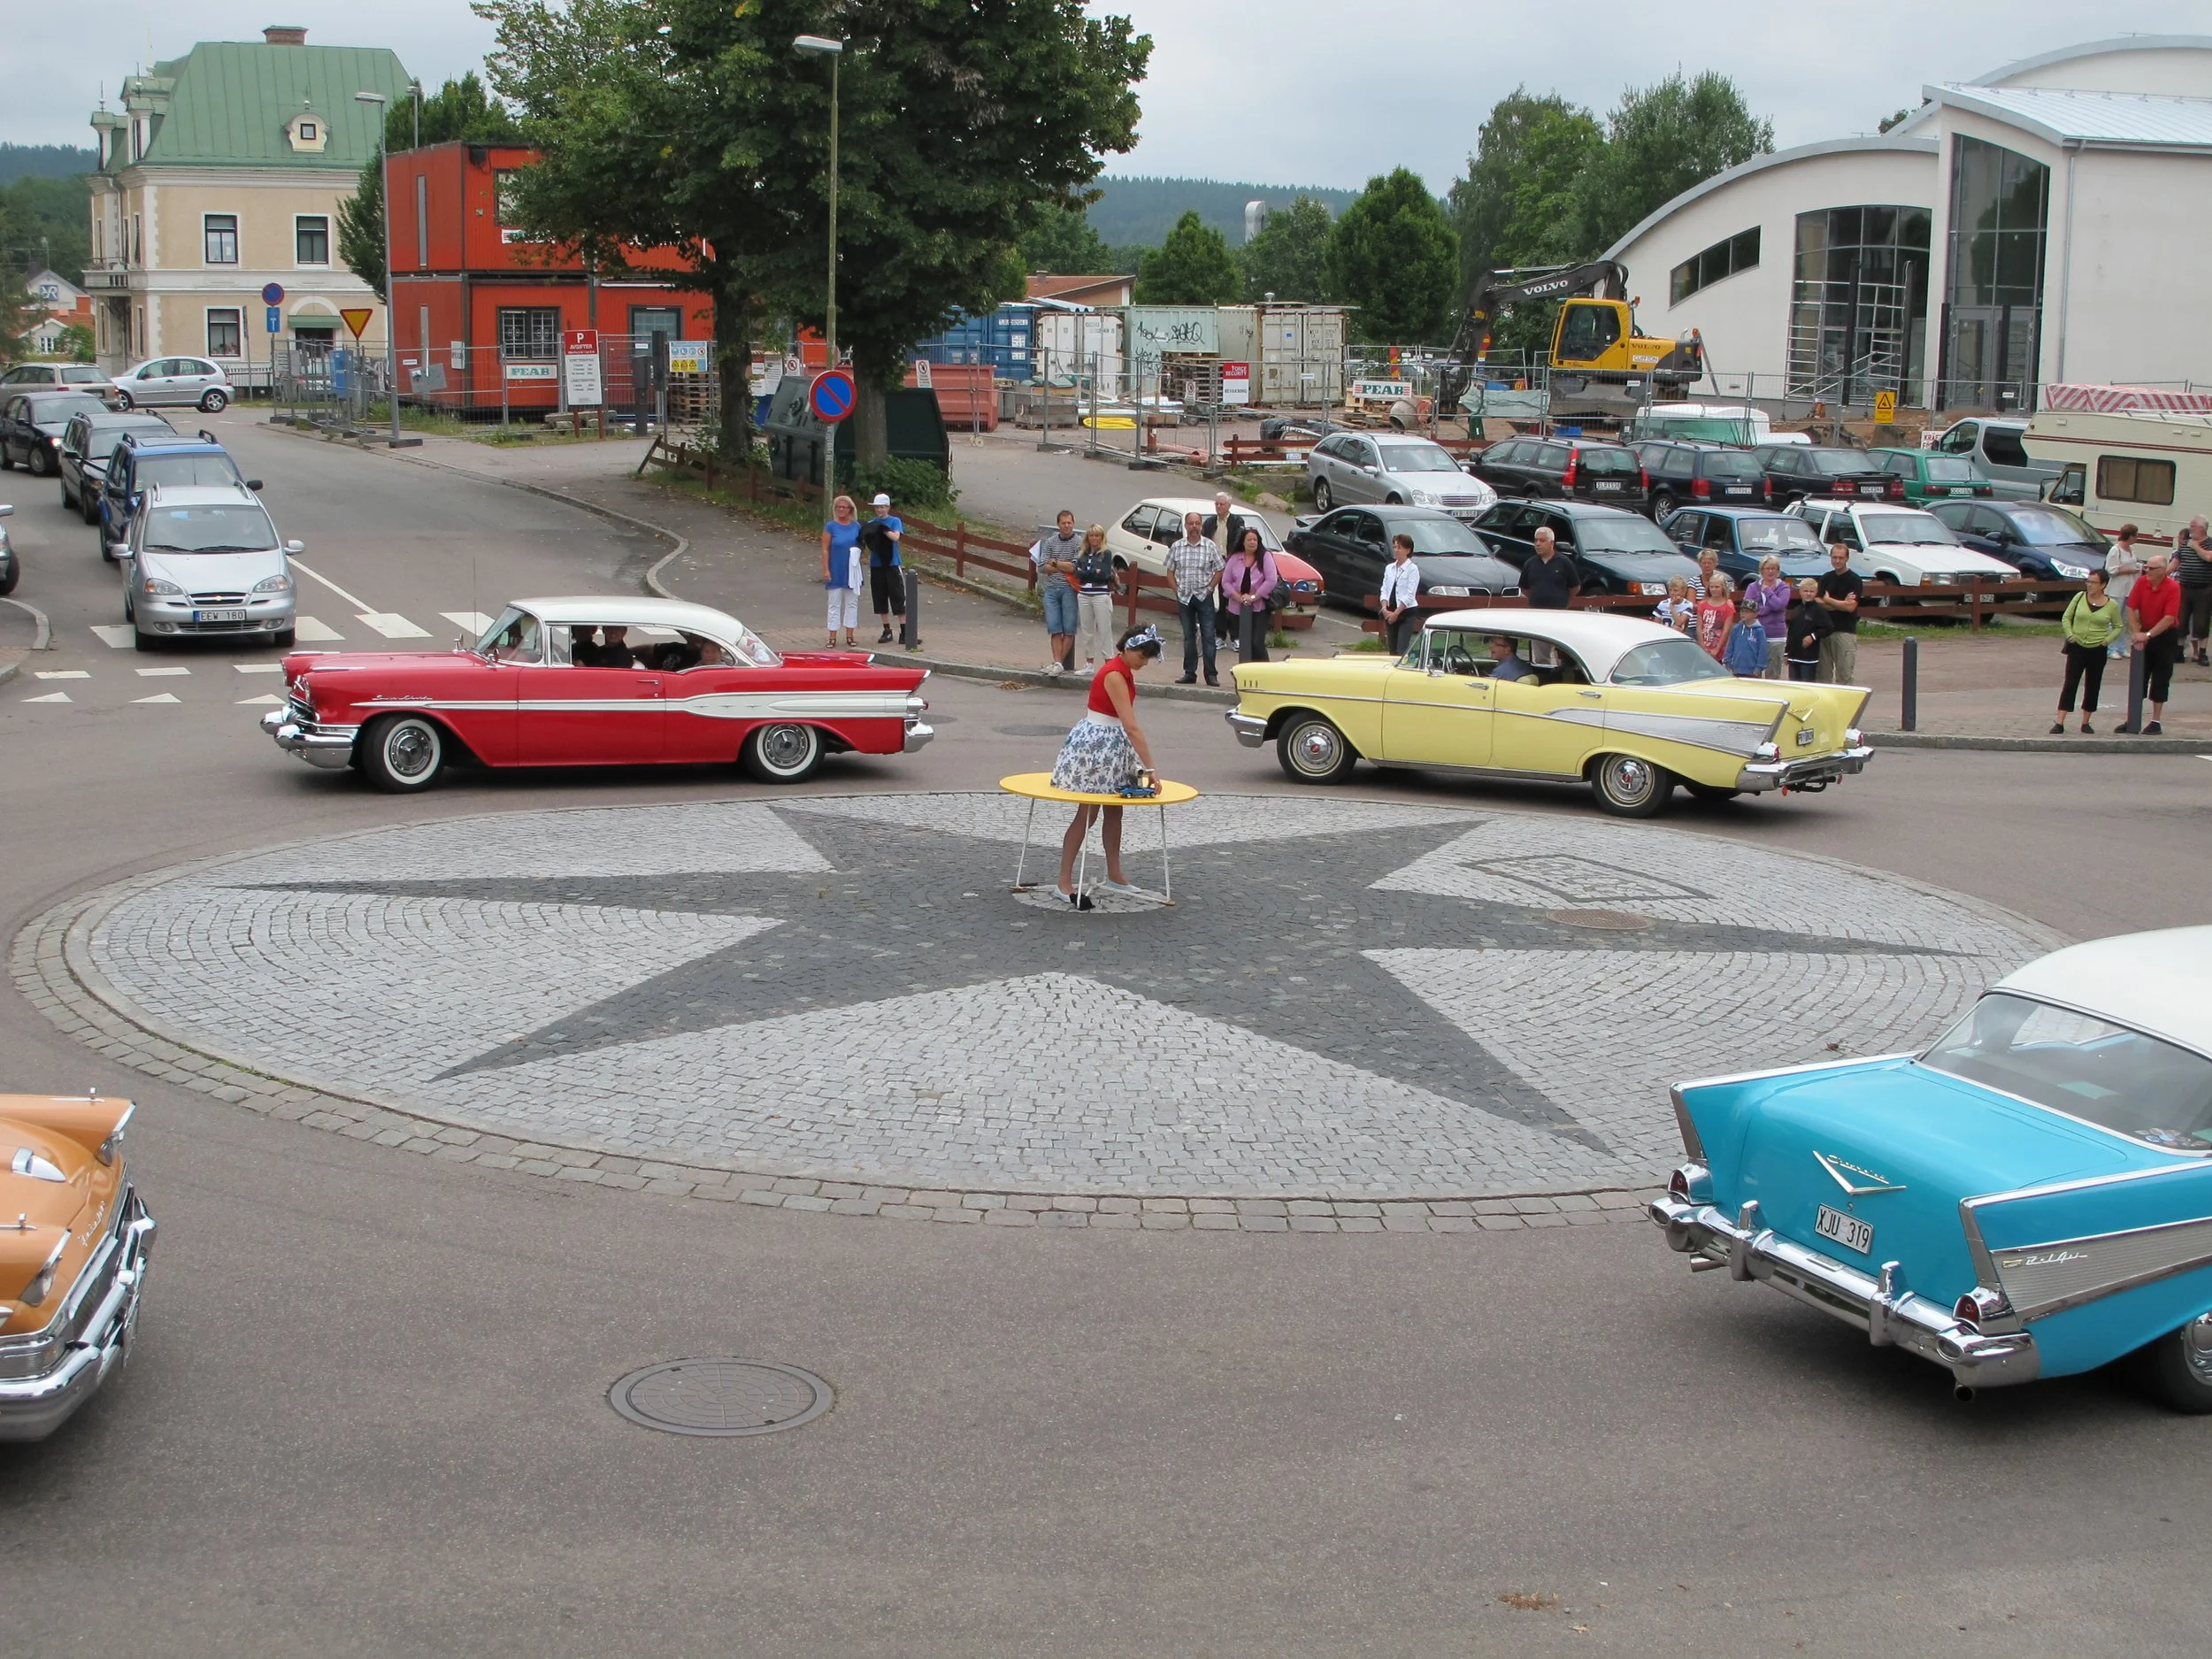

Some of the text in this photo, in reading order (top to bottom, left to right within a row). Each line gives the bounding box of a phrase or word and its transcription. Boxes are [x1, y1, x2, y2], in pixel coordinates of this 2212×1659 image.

[1523, 280, 1569, 296] VOLVO
[576, 332, 584, 343] P
[511, 367, 550, 376] PEAB
[1362, 384, 1403, 395] PEAB
[201, 611, 219, 620] EEW
[1816, 1208, 1870, 1249] XJU 319
